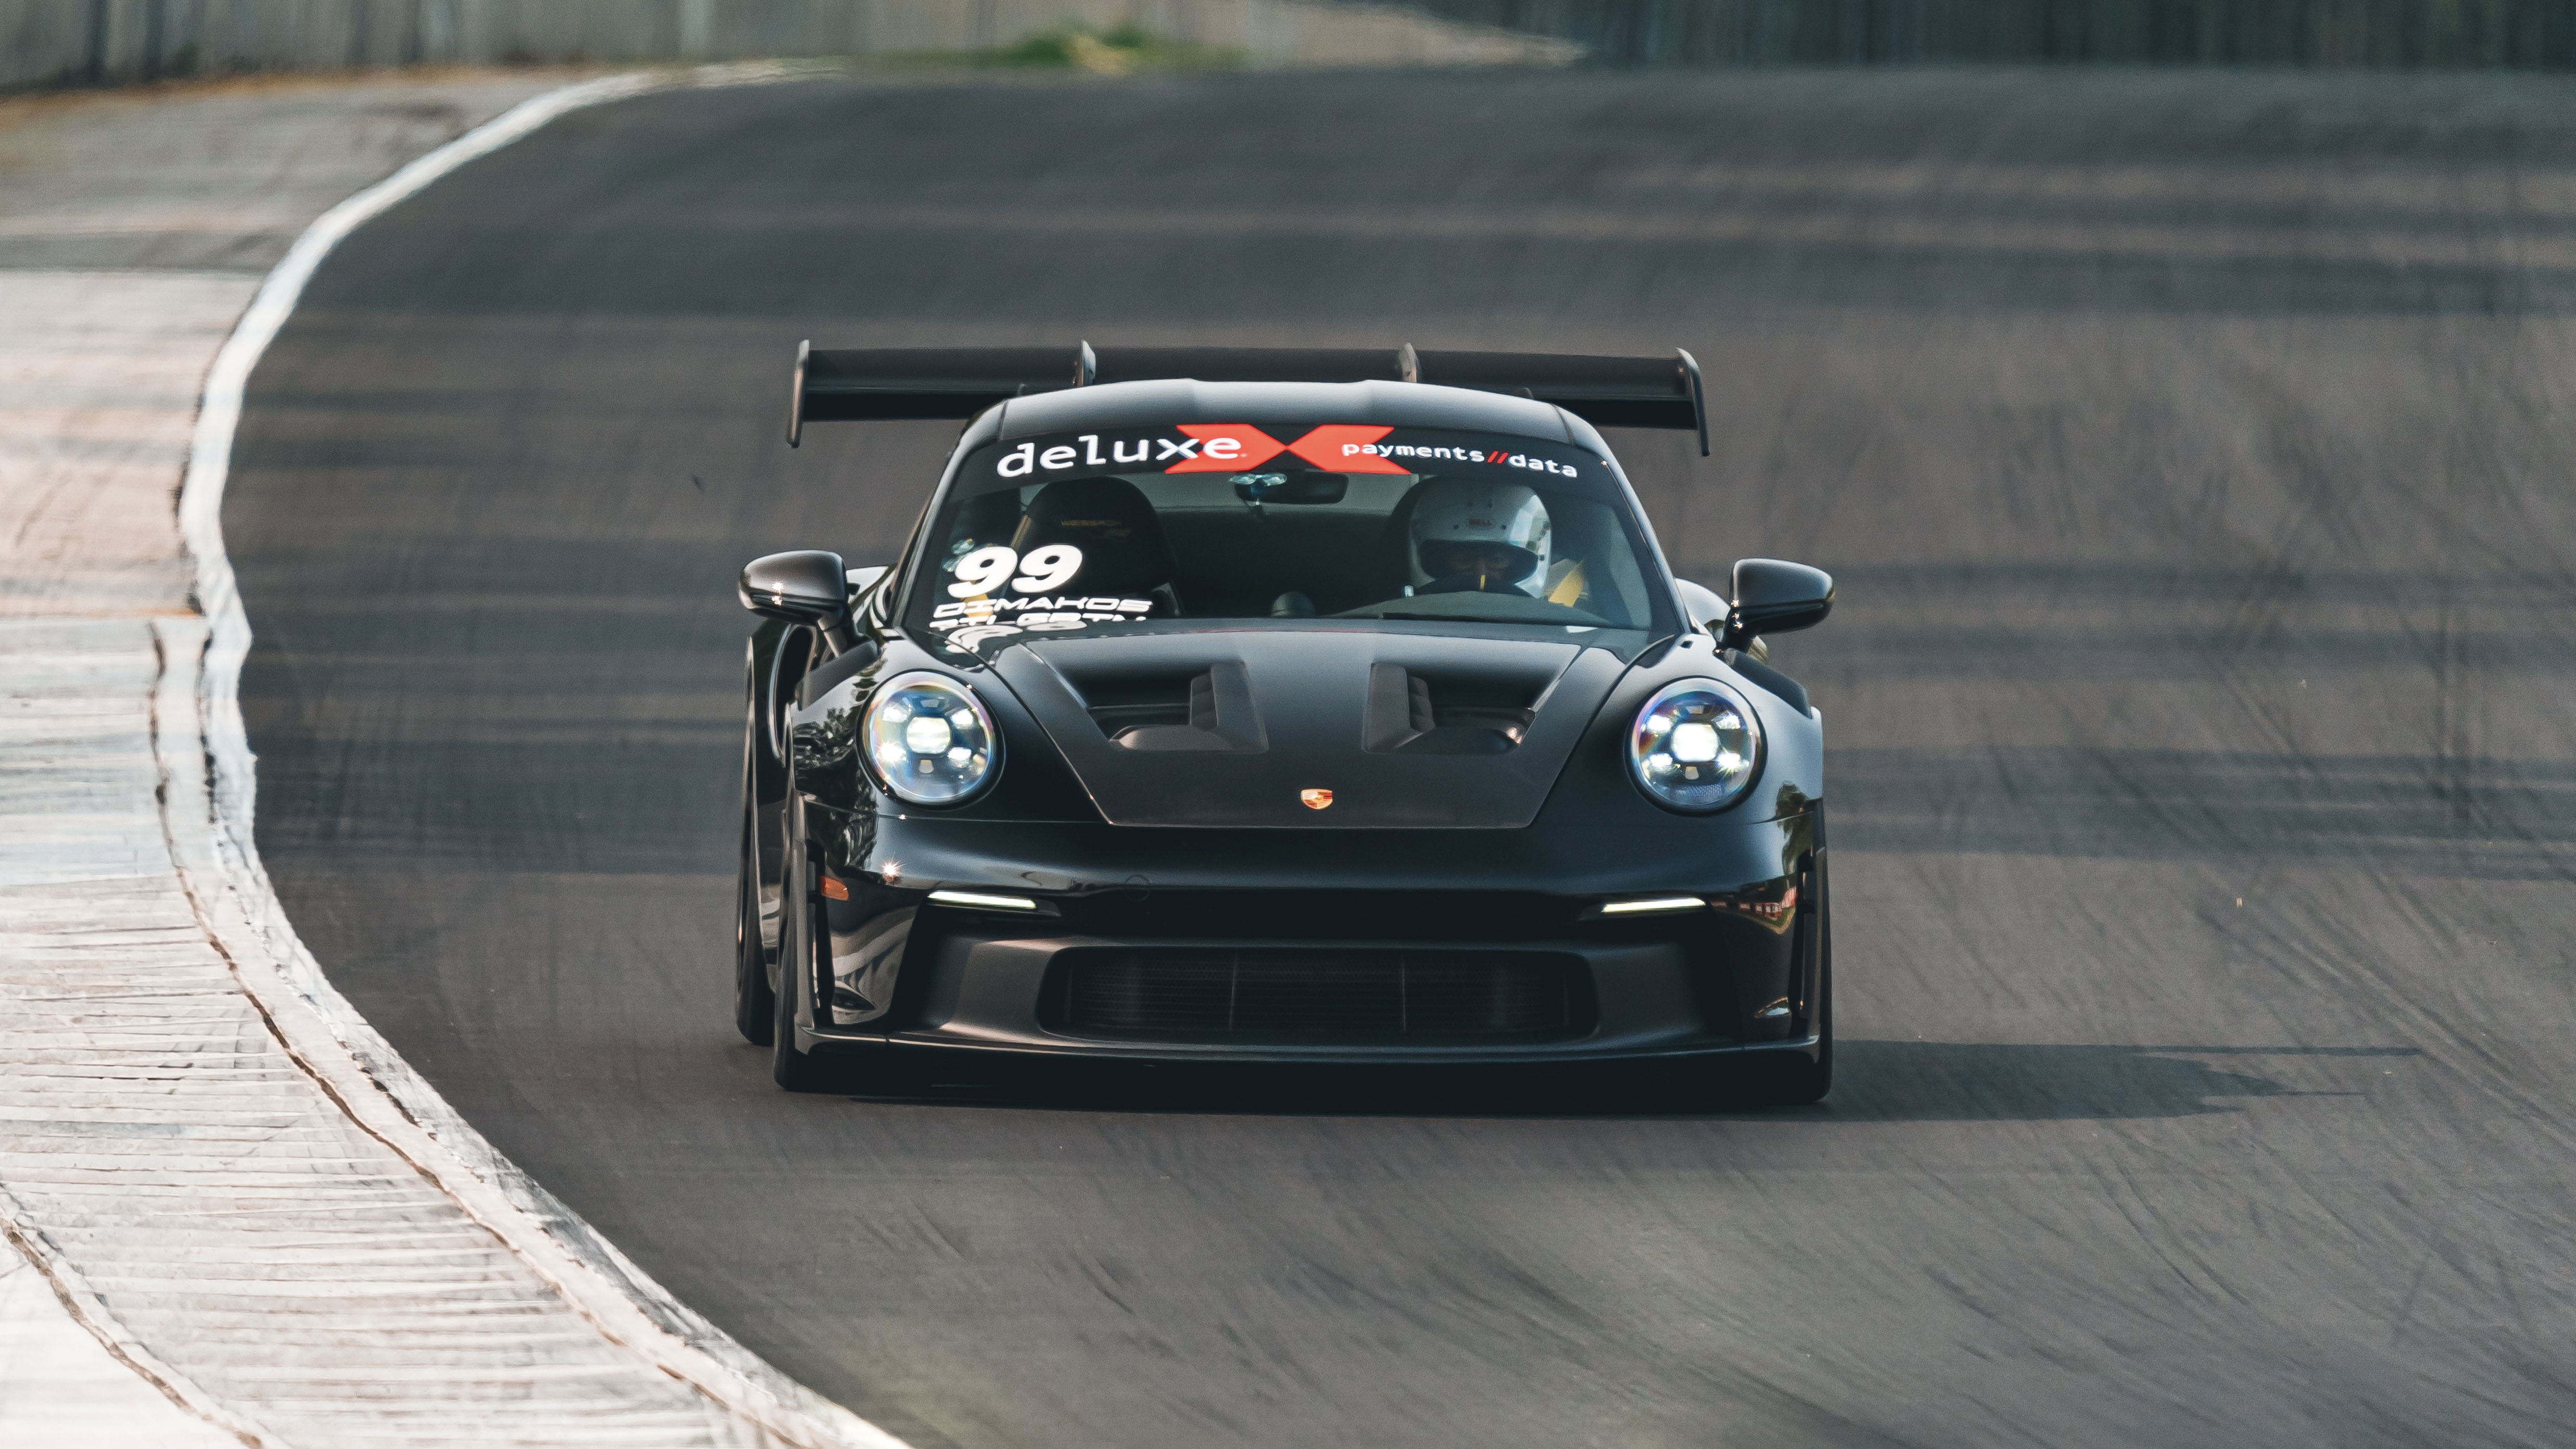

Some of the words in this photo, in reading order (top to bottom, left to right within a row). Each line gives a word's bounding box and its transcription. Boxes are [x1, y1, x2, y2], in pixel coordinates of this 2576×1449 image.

[997, 434, 1242, 477] deluxe
[948, 545, 1083, 598] 99
[933, 597, 1153, 618] DIMAKOS
